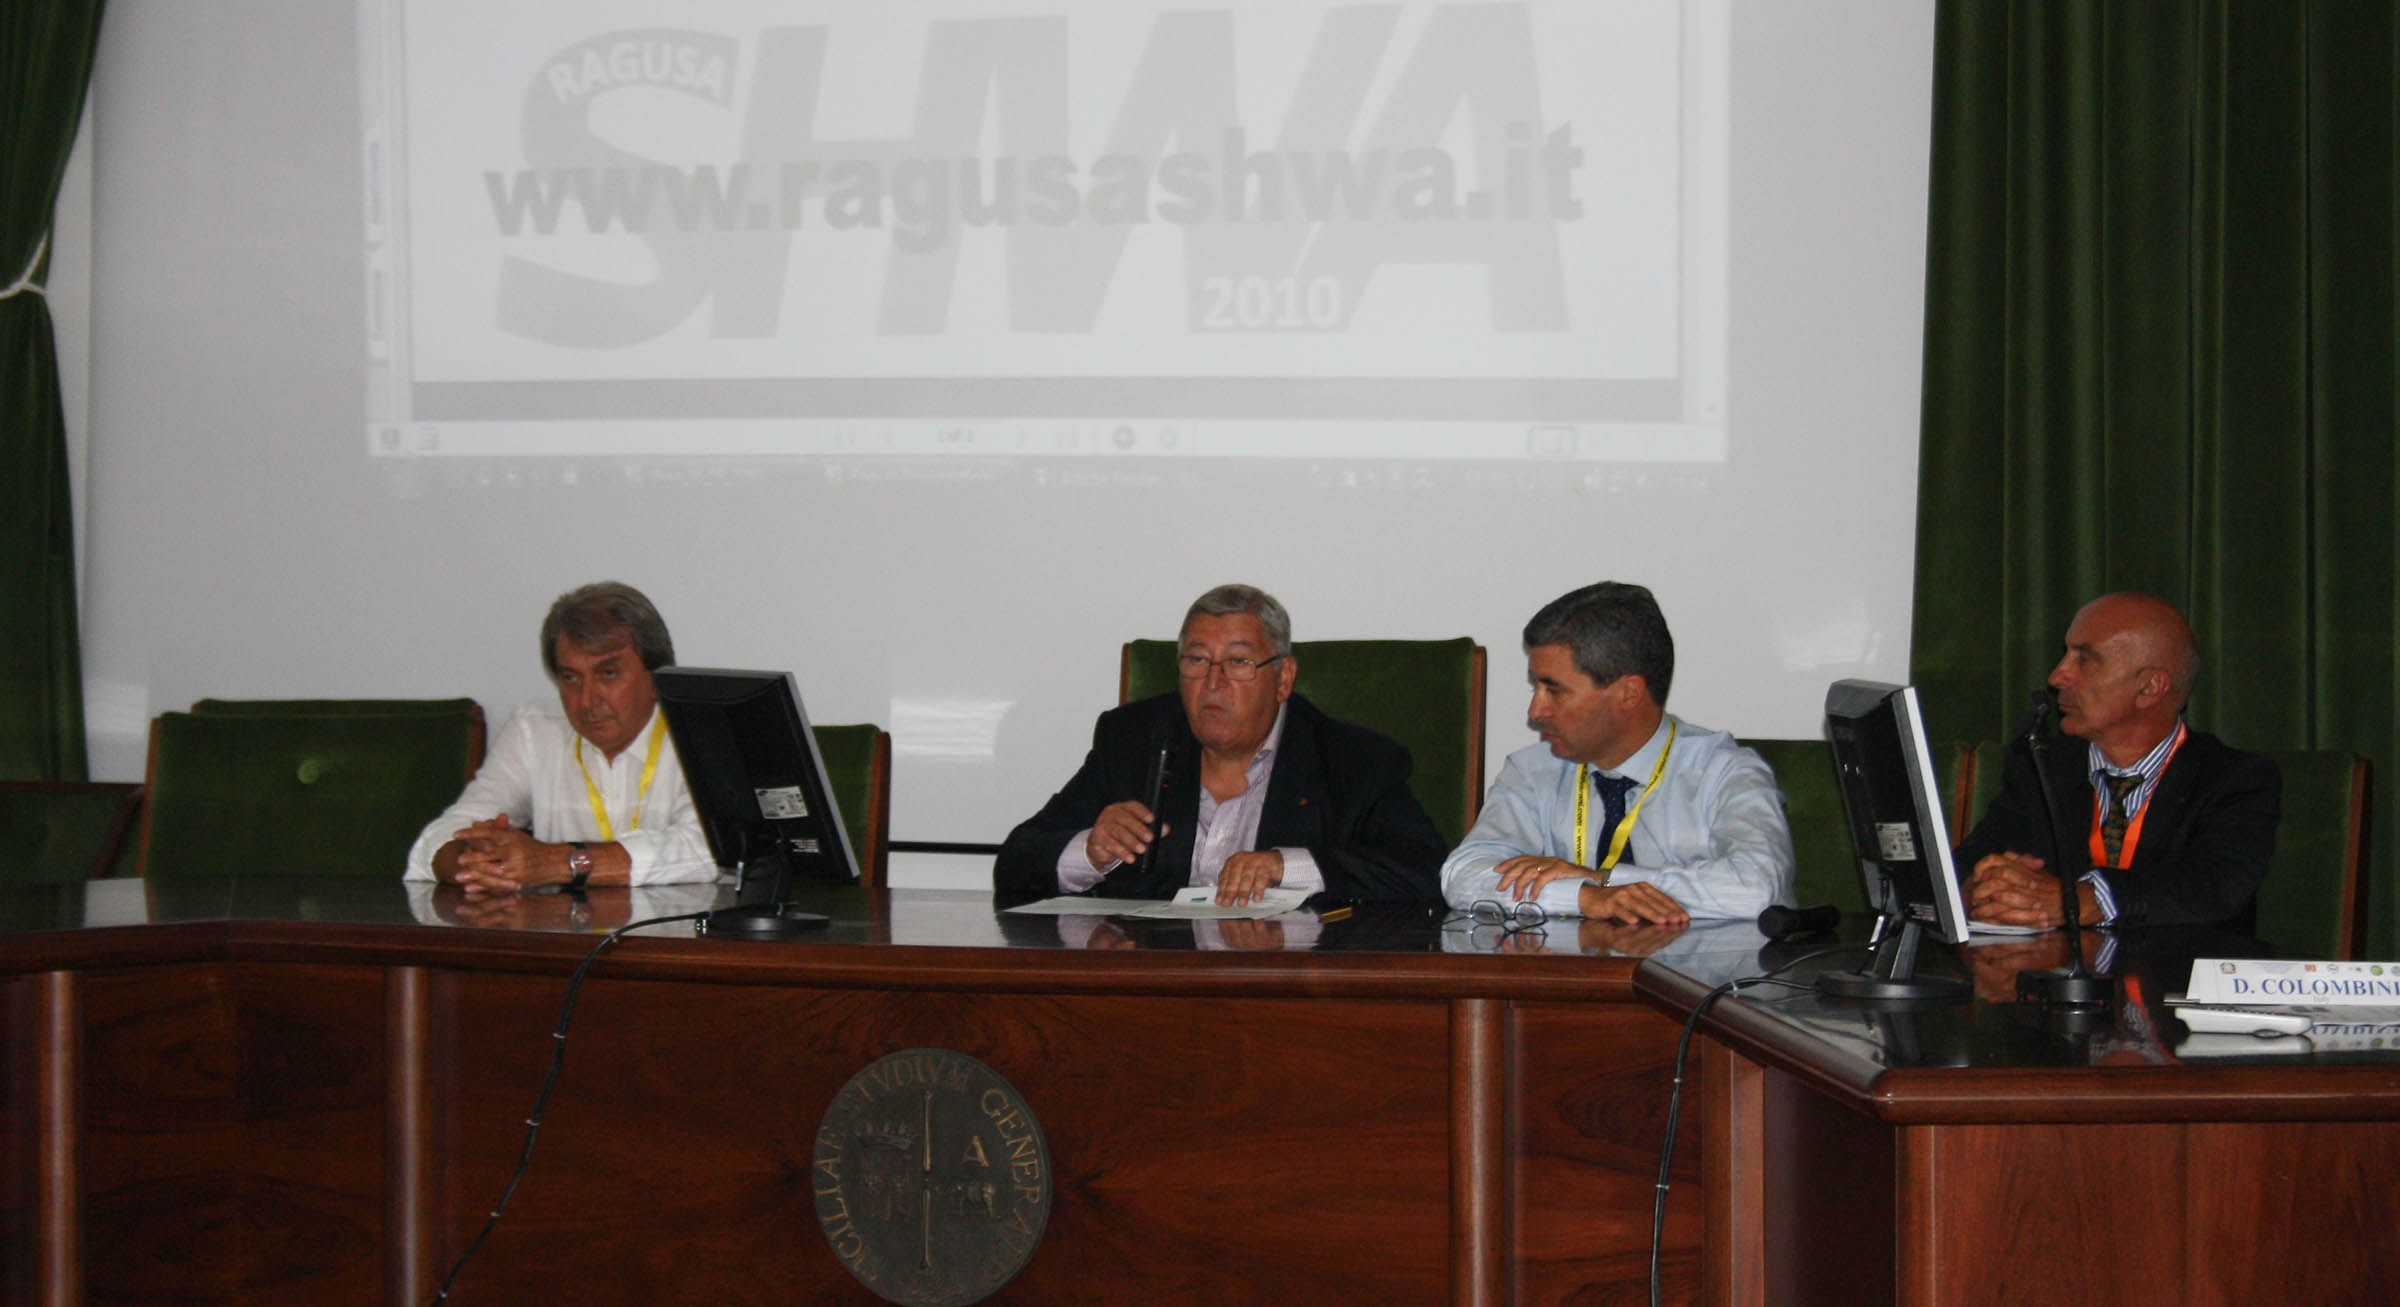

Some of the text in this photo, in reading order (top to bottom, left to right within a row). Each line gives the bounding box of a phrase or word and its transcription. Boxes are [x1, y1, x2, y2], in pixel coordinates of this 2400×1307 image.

[548, 40, 728, 105] RAGUSA
[483, 120, 1585, 255] www.ragusashwa.it
[494, 2, 1571, 351] SHWA
[1202, 275, 1343, 330] 2010
[2232, 978, 2400, 997] D. COLOMBINI
